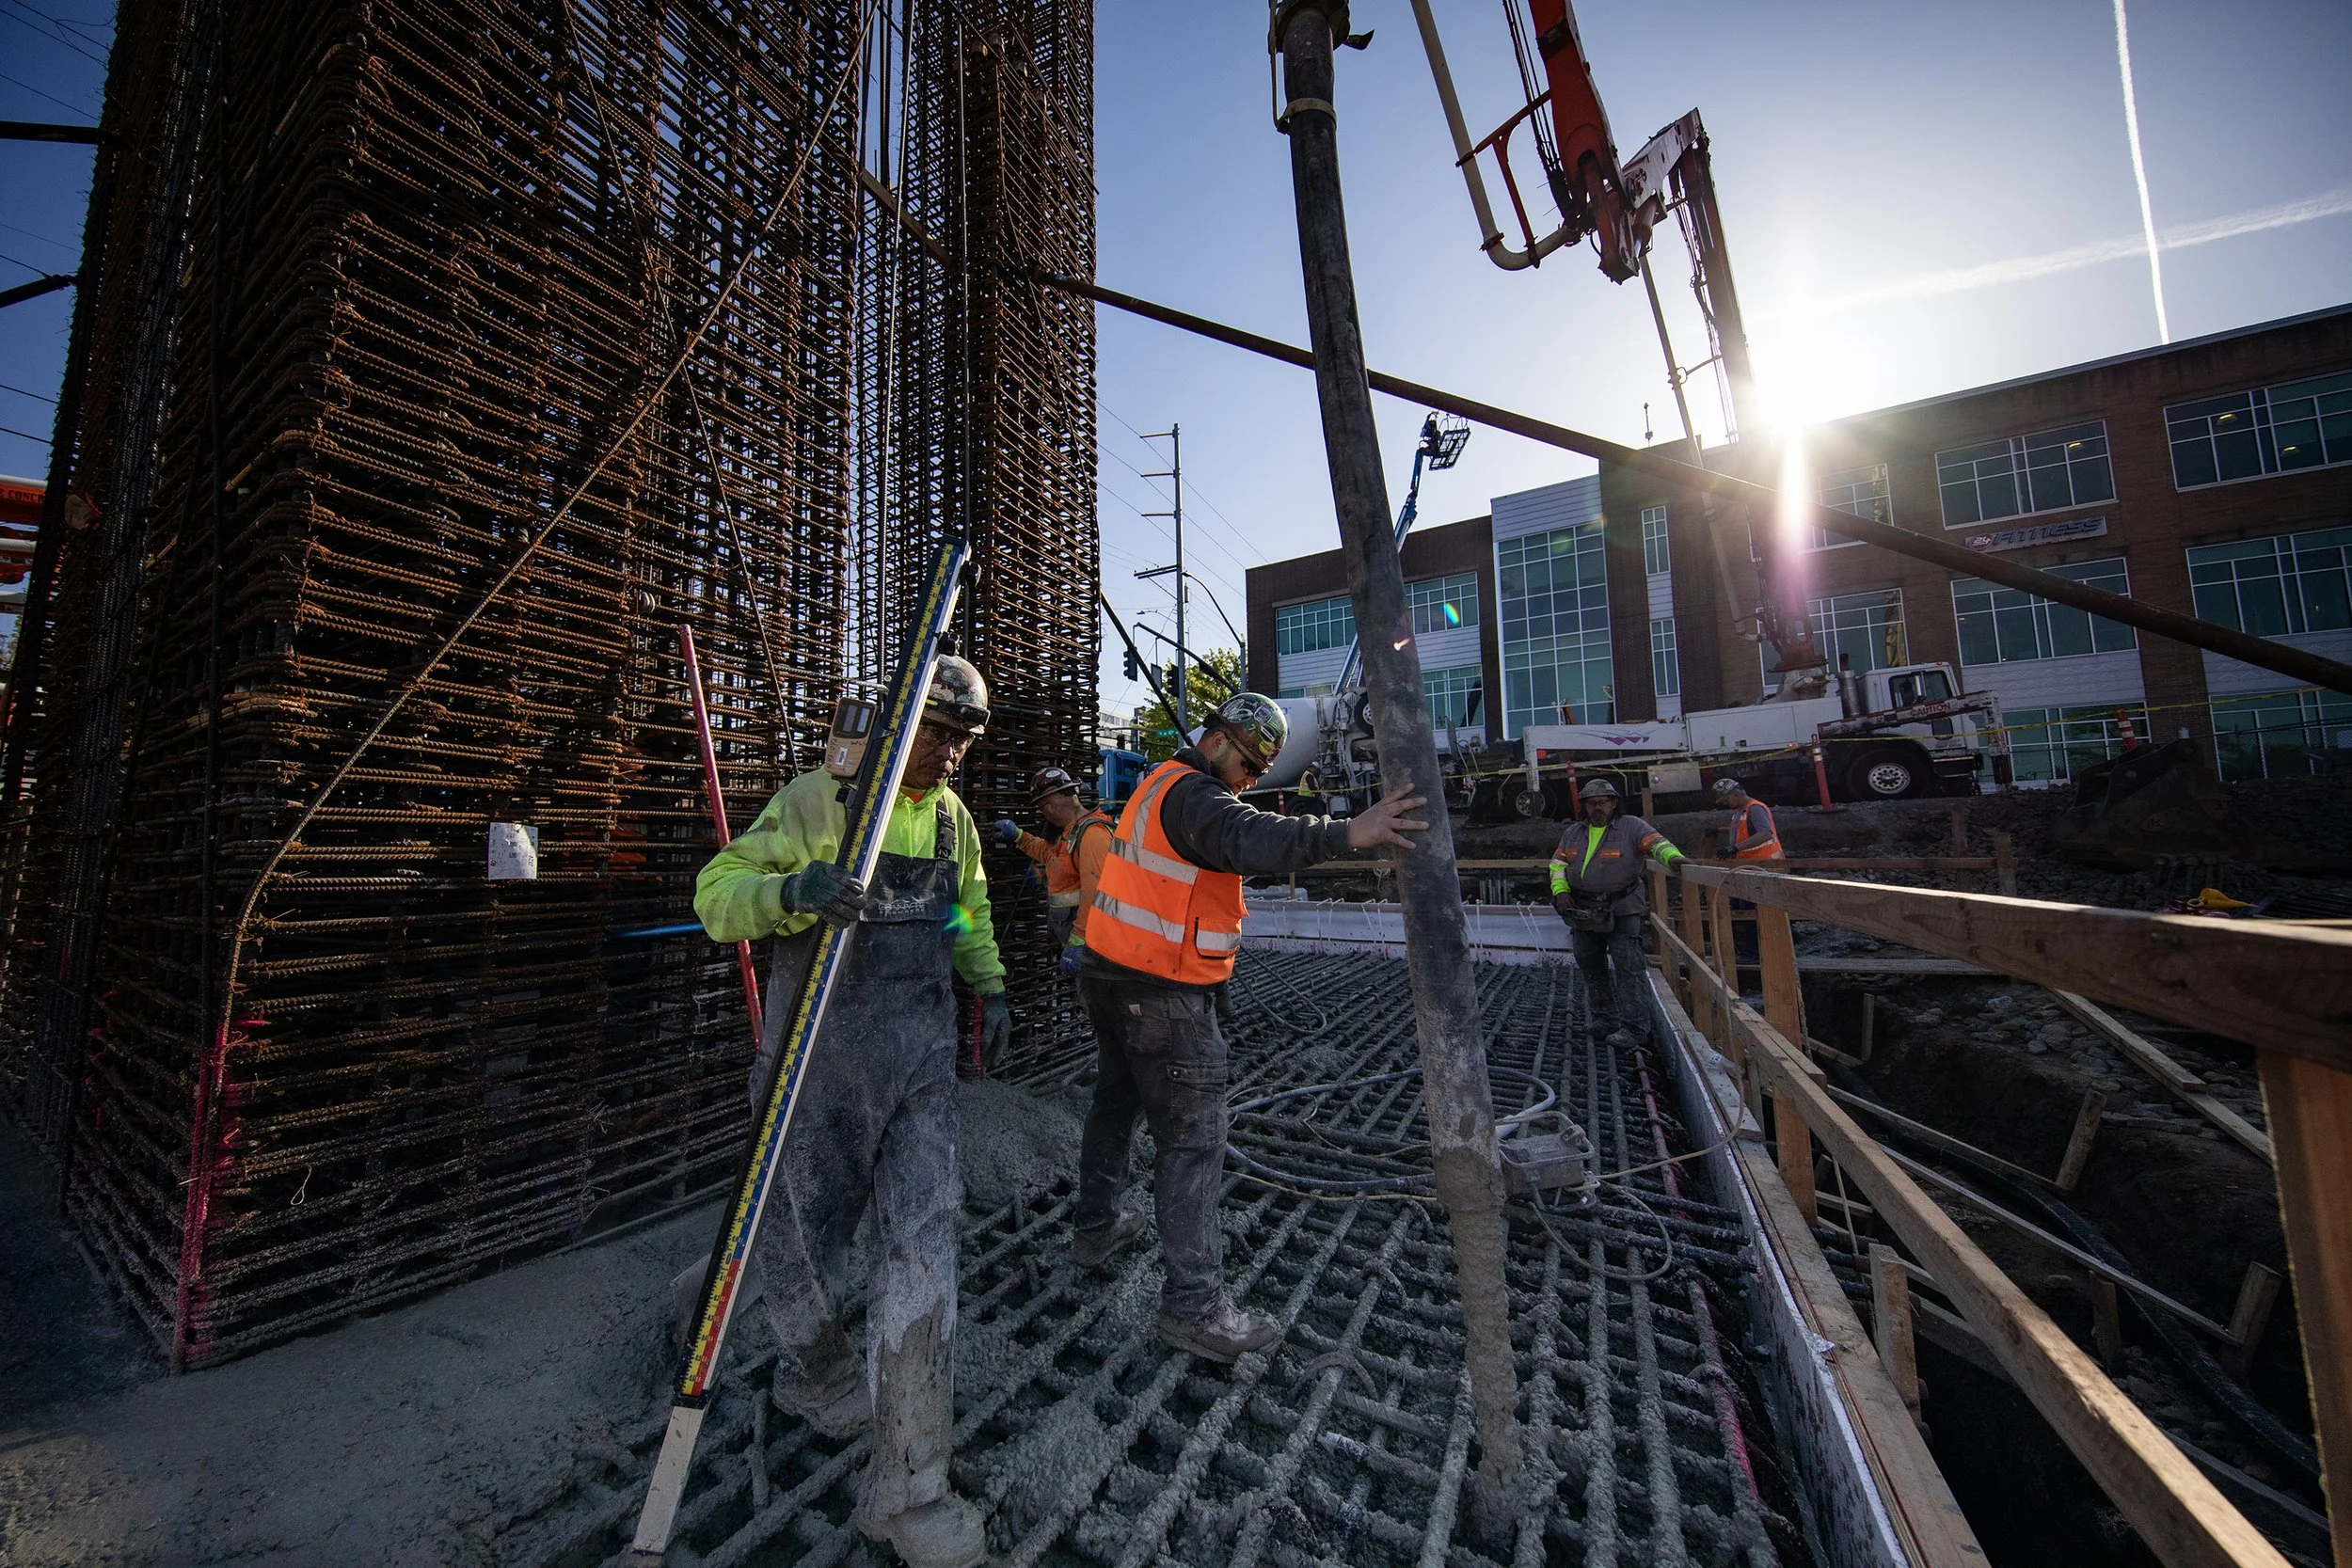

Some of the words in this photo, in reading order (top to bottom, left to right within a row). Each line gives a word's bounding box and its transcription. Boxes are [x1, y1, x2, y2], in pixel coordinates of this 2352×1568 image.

[1973, 535, 1992, 546] 24
[1993, 517, 2103, 546] FITNESS
[1910, 702, 1951, 717] CAUTION
